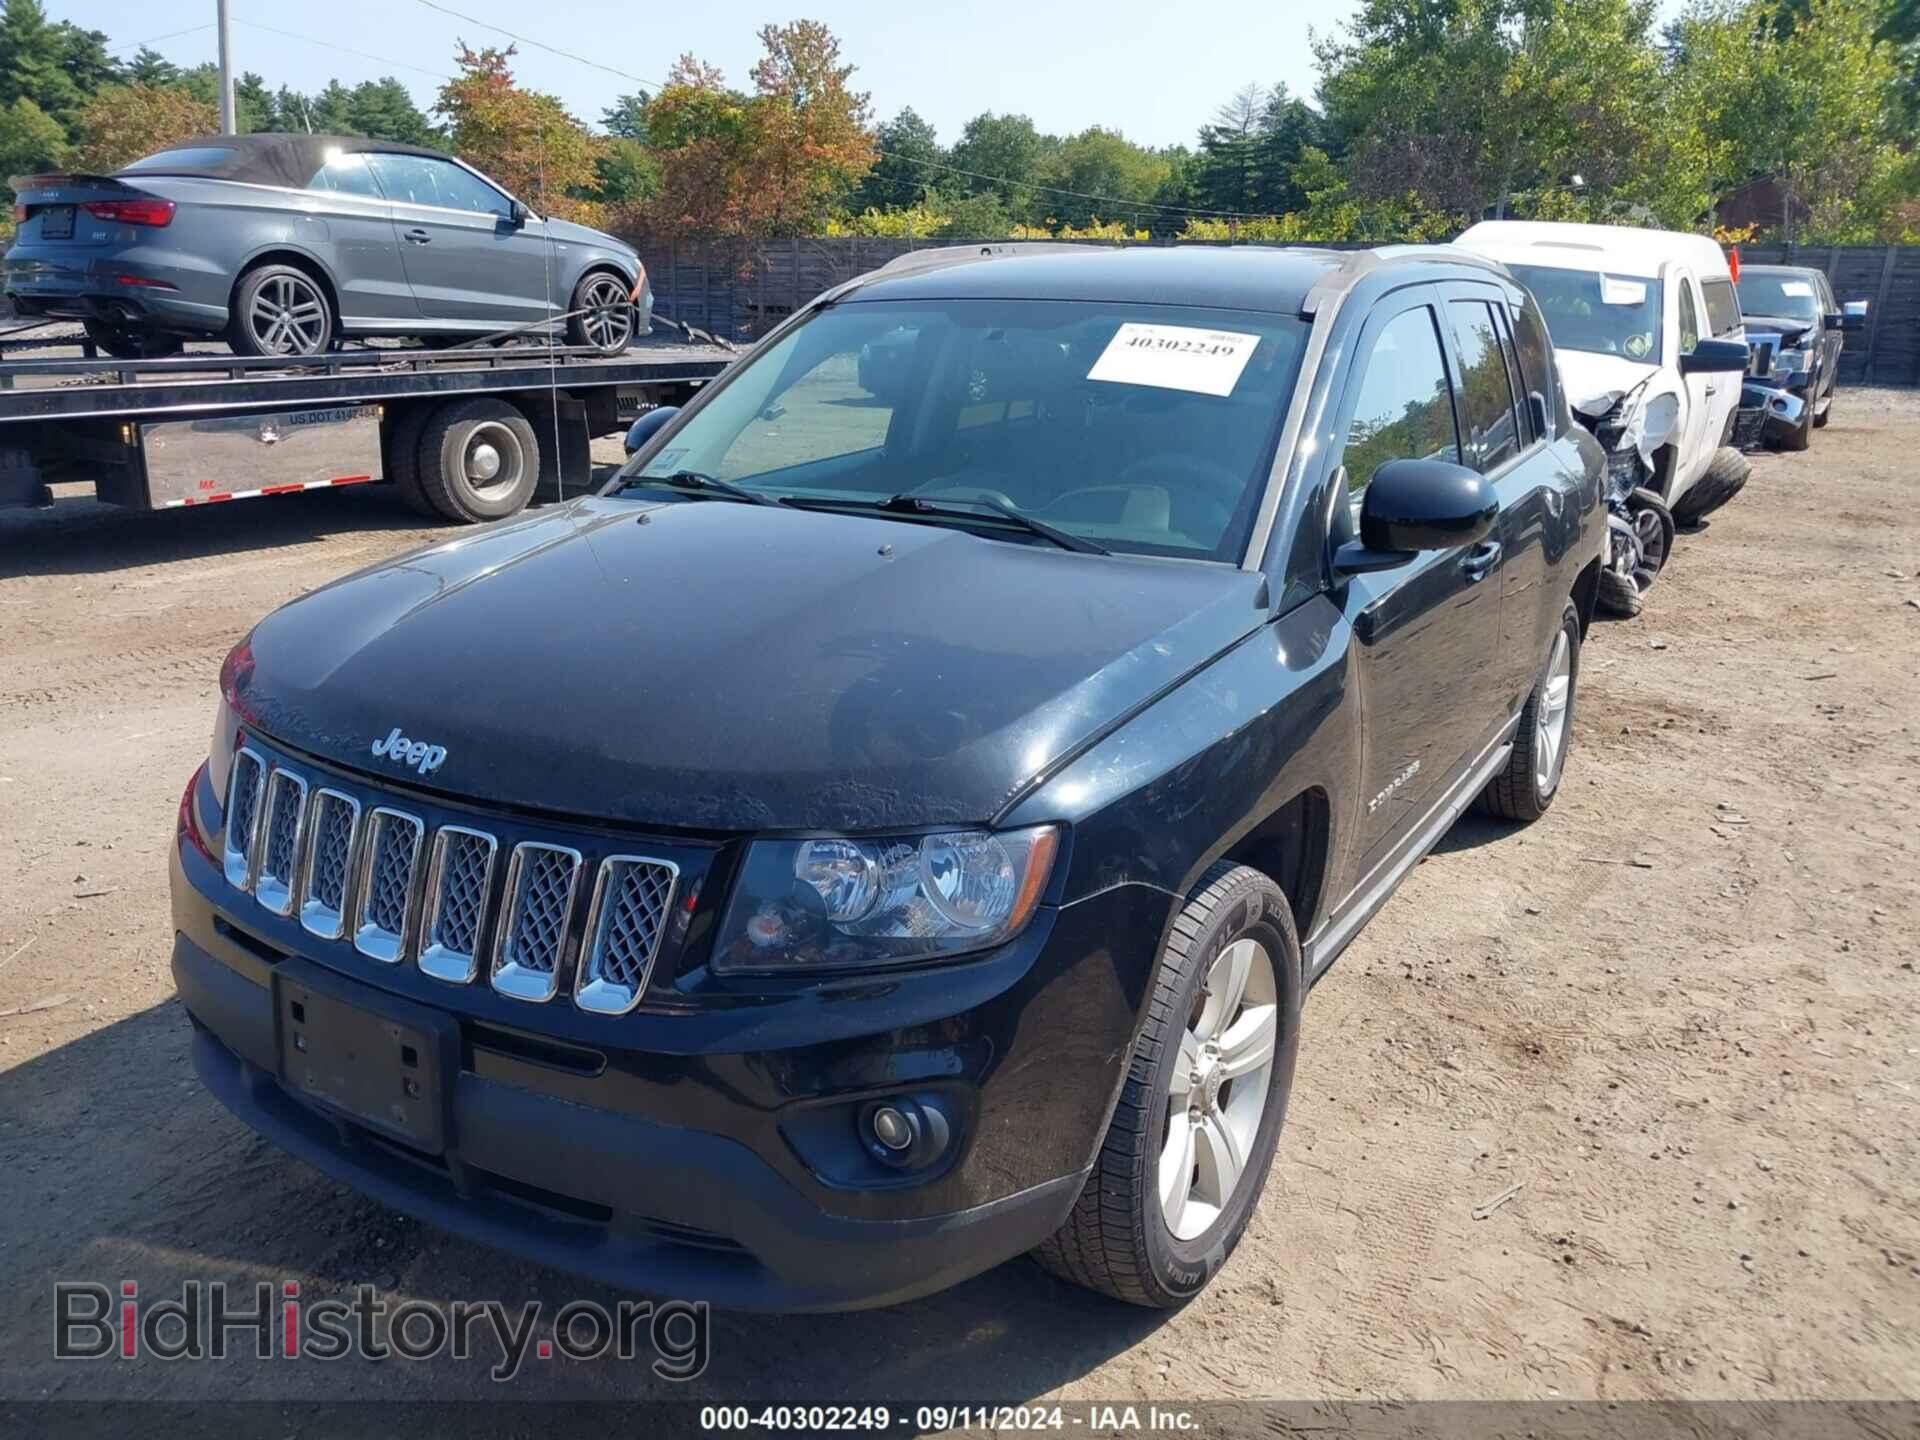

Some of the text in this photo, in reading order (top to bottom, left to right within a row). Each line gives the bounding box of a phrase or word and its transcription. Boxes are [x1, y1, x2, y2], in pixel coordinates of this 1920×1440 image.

[1125, 336, 1235, 356] 40302249
[289, 412, 306, 425] US
[309, 410, 333, 424] DOT
[371, 727, 448, 774] Jeep
